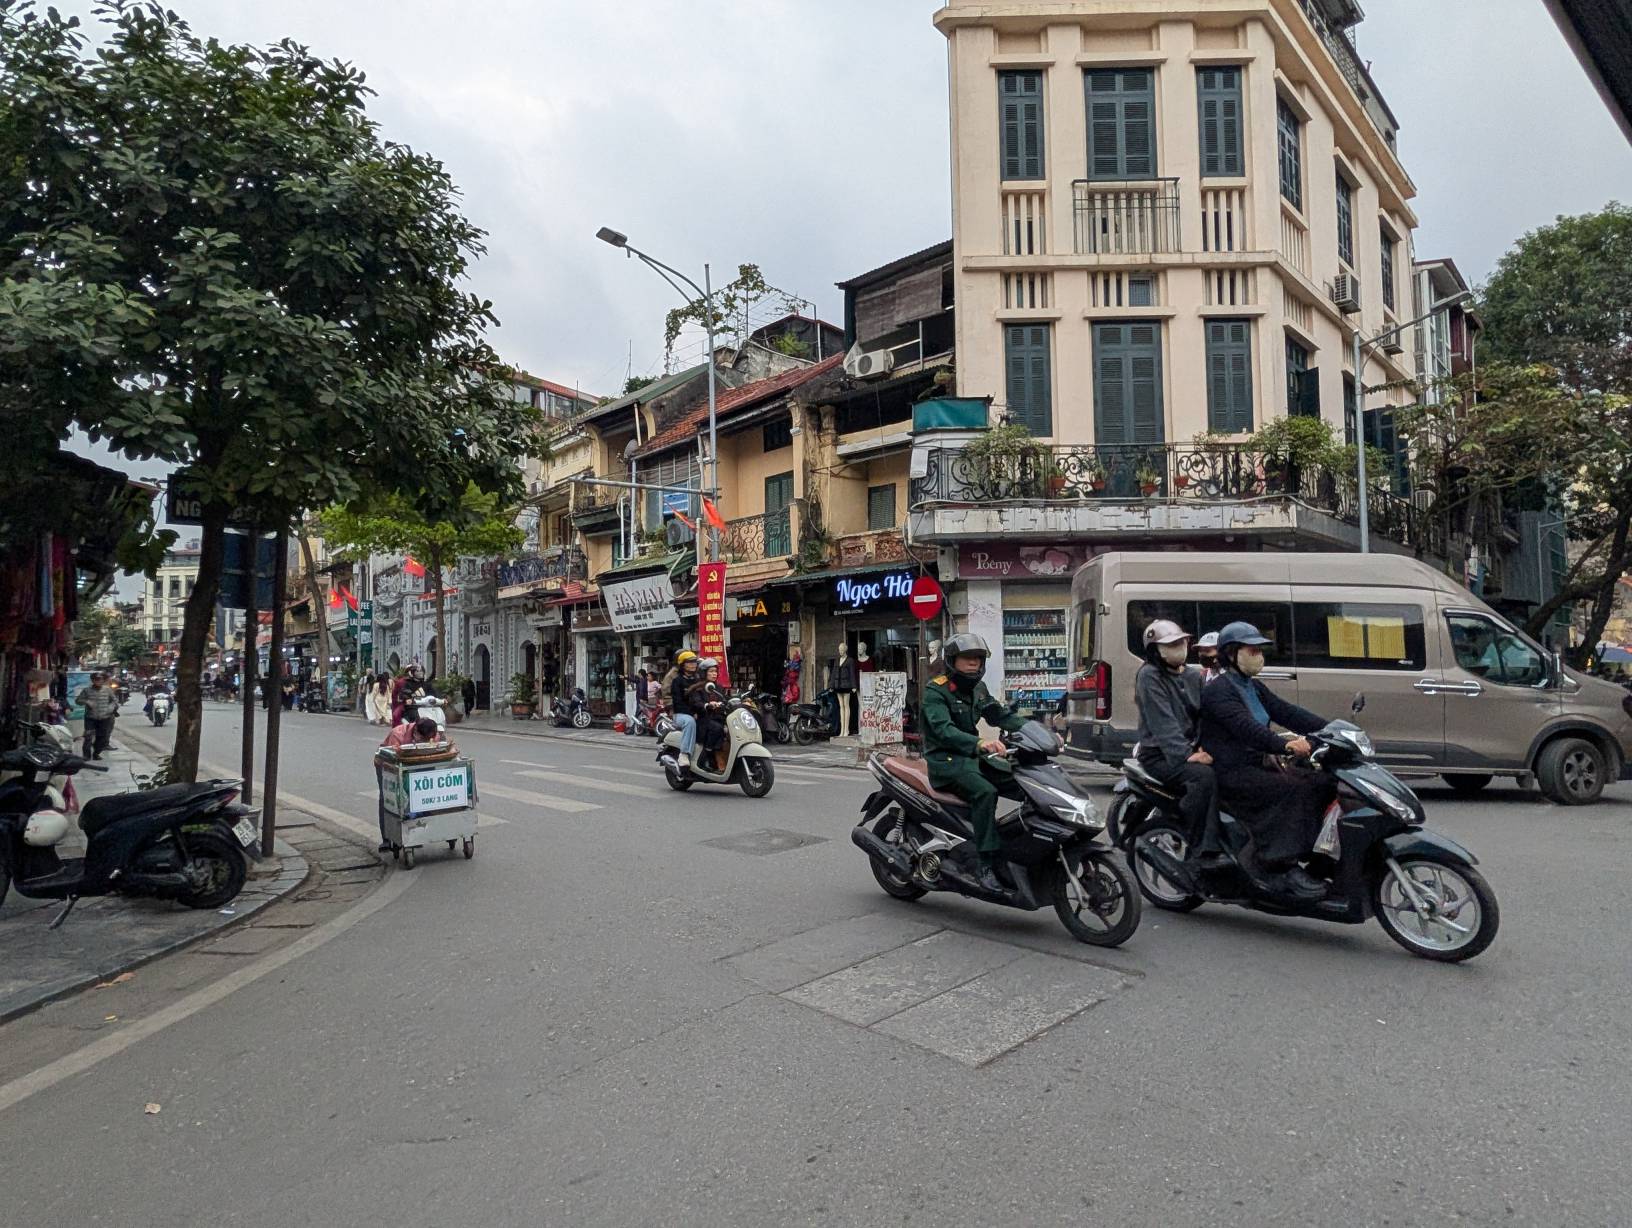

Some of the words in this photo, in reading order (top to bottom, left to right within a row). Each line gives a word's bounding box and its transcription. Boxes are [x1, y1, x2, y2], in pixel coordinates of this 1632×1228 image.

[836, 579, 881, 608] Ngọc
[883, 571, 913, 598] Hà
[414, 776, 434, 792] XÔI
[437, 772, 463, 789] CỐM
